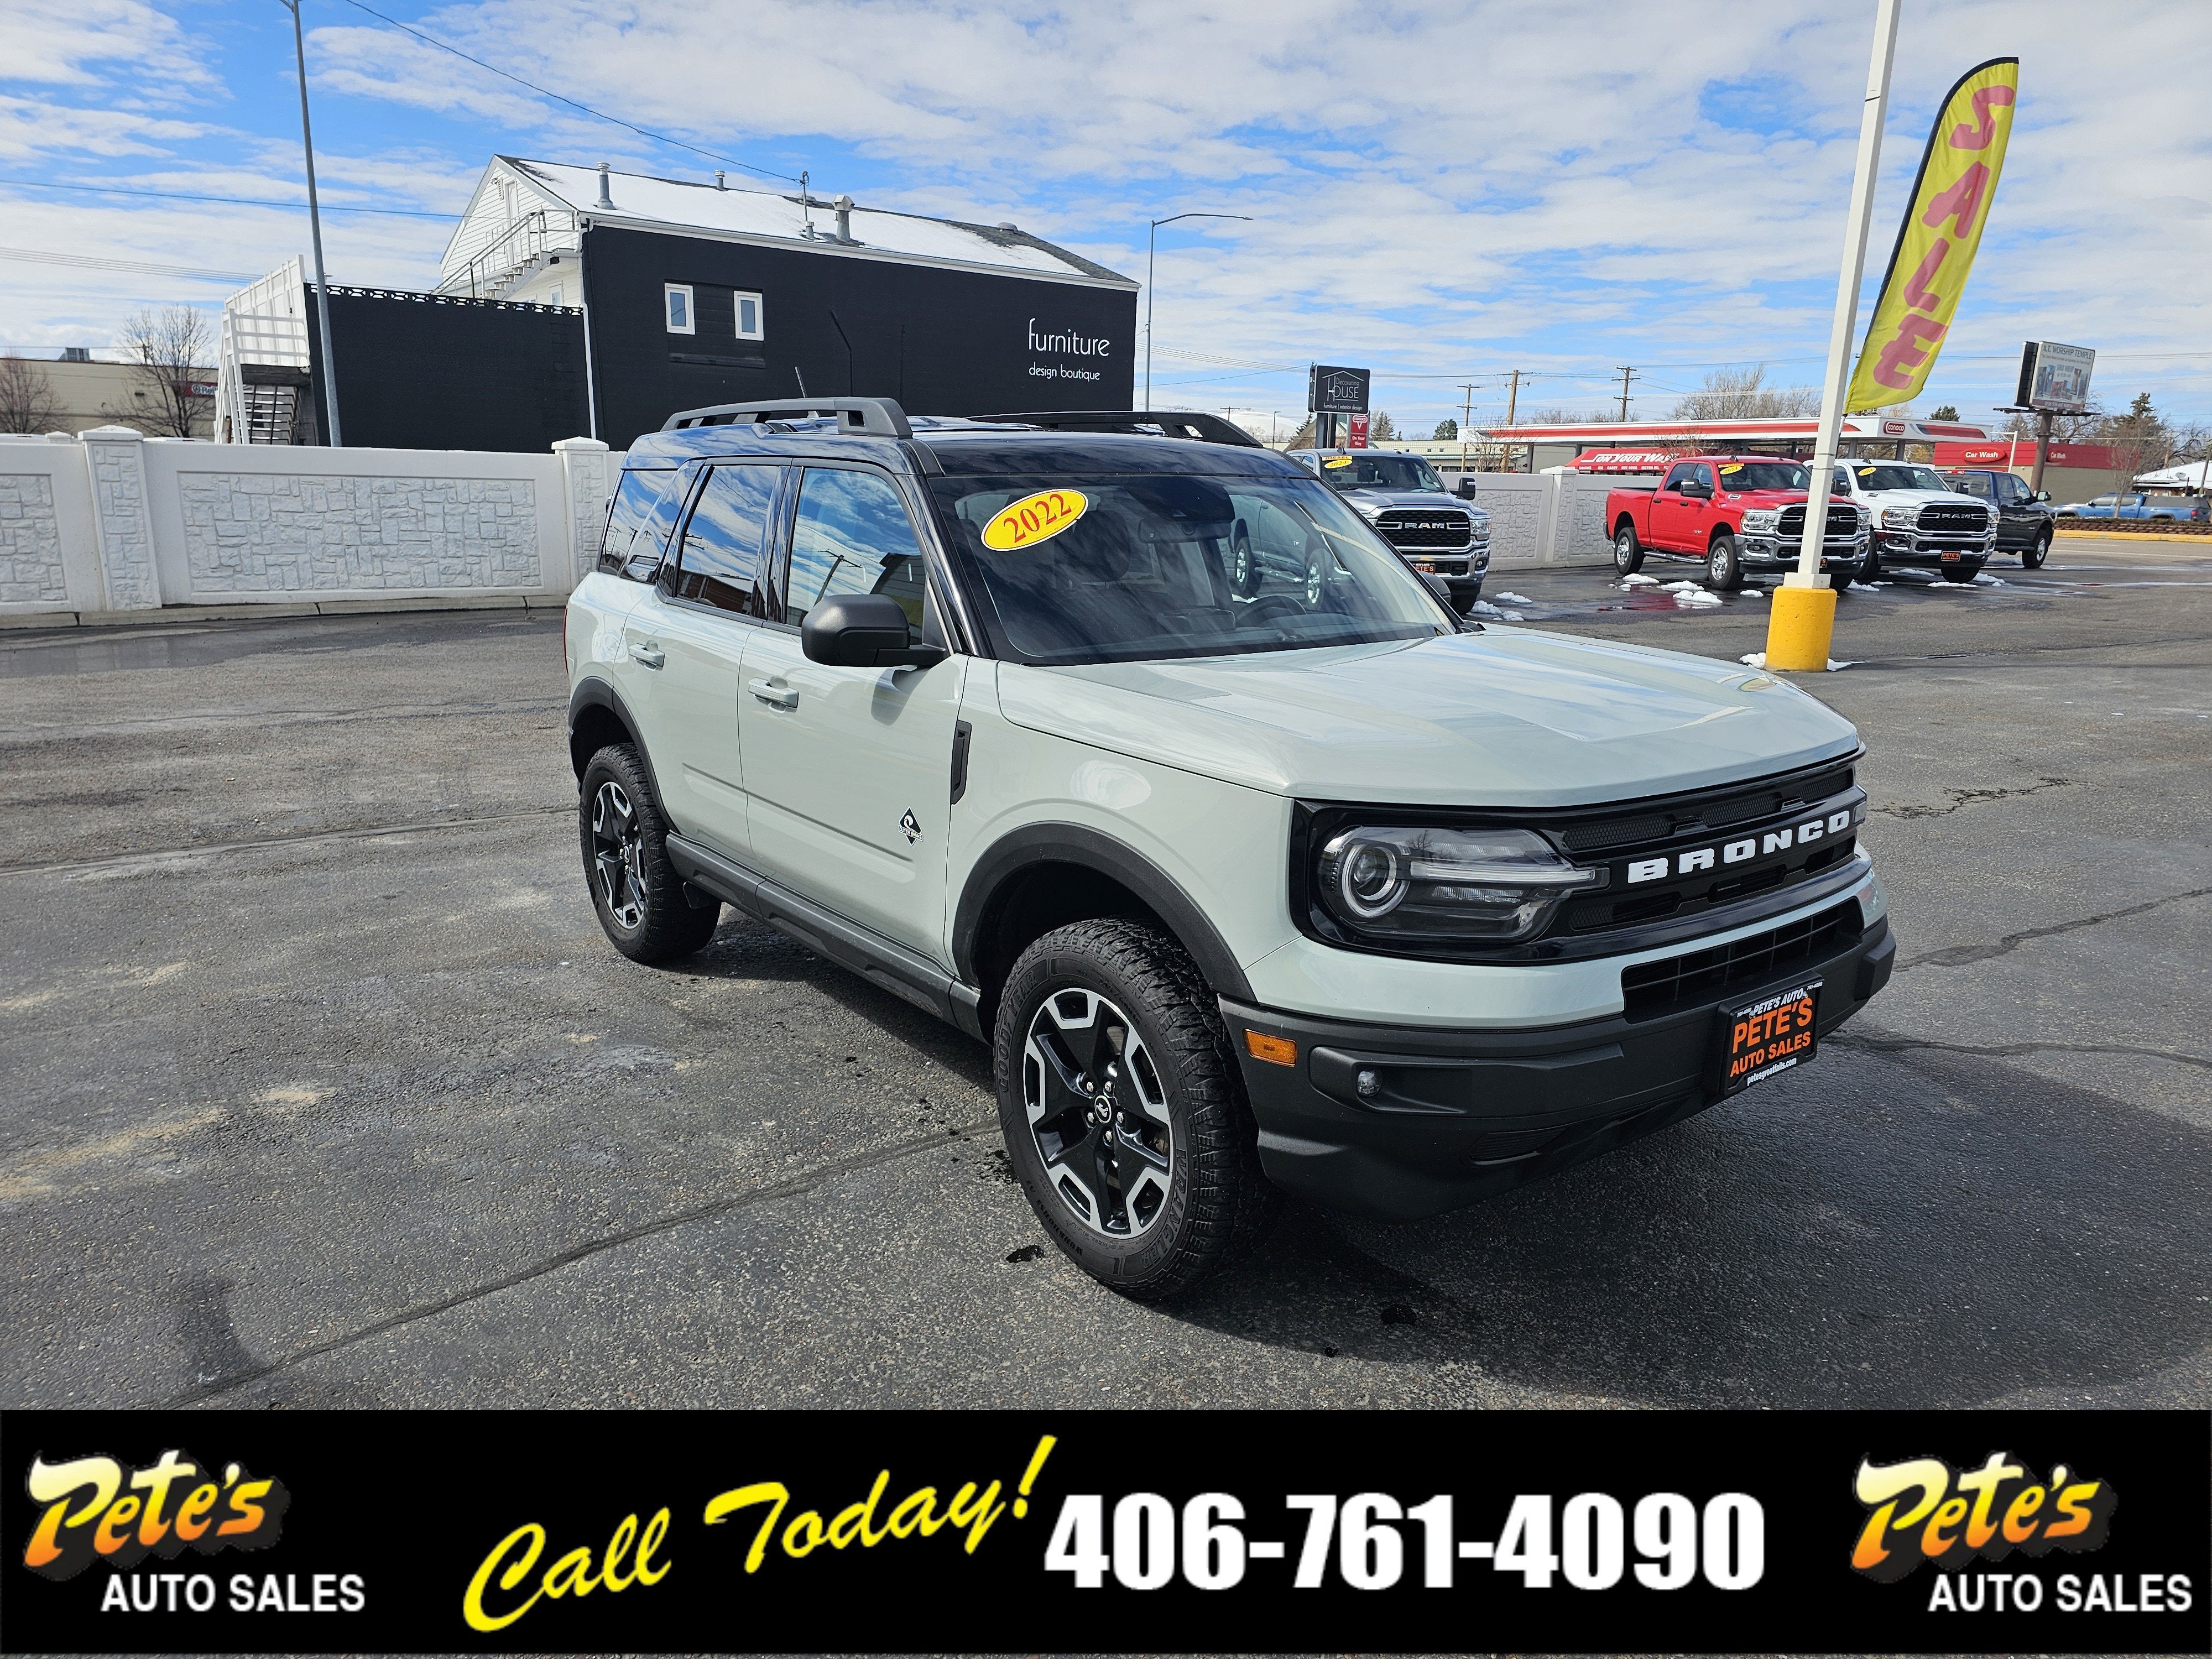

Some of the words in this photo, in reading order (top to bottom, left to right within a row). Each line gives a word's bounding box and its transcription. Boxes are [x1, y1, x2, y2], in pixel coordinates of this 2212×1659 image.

[1873, 85, 2015, 389] SALE
[1029, 317, 1110, 356] furniture
[2053, 347, 2074, 355] WORSHIP
[2075, 349, 2093, 359] TEMPLE
[1029, 361, 1057, 379] design
[1060, 363, 1100, 382] boutique
[1336, 377, 1359, 387] Decorating
[1327, 376, 1359, 402] HOUSE
[1610, 453, 1644, 463] YOUR
[1003, 493, 1072, 543] 2022
[1627, 811, 1850, 884] BRONCO
[1753, 996, 1781, 1015] PETE'S
[1781, 988, 1804, 1006] AUTO
[1733, 997, 1813, 1054] PETE'S
[1730, 1048, 1765, 1077] AUTO
[1768, 1031, 1811, 1060] SALES
[1747, 1057, 1797, 1087] petesgreatfalls.com
